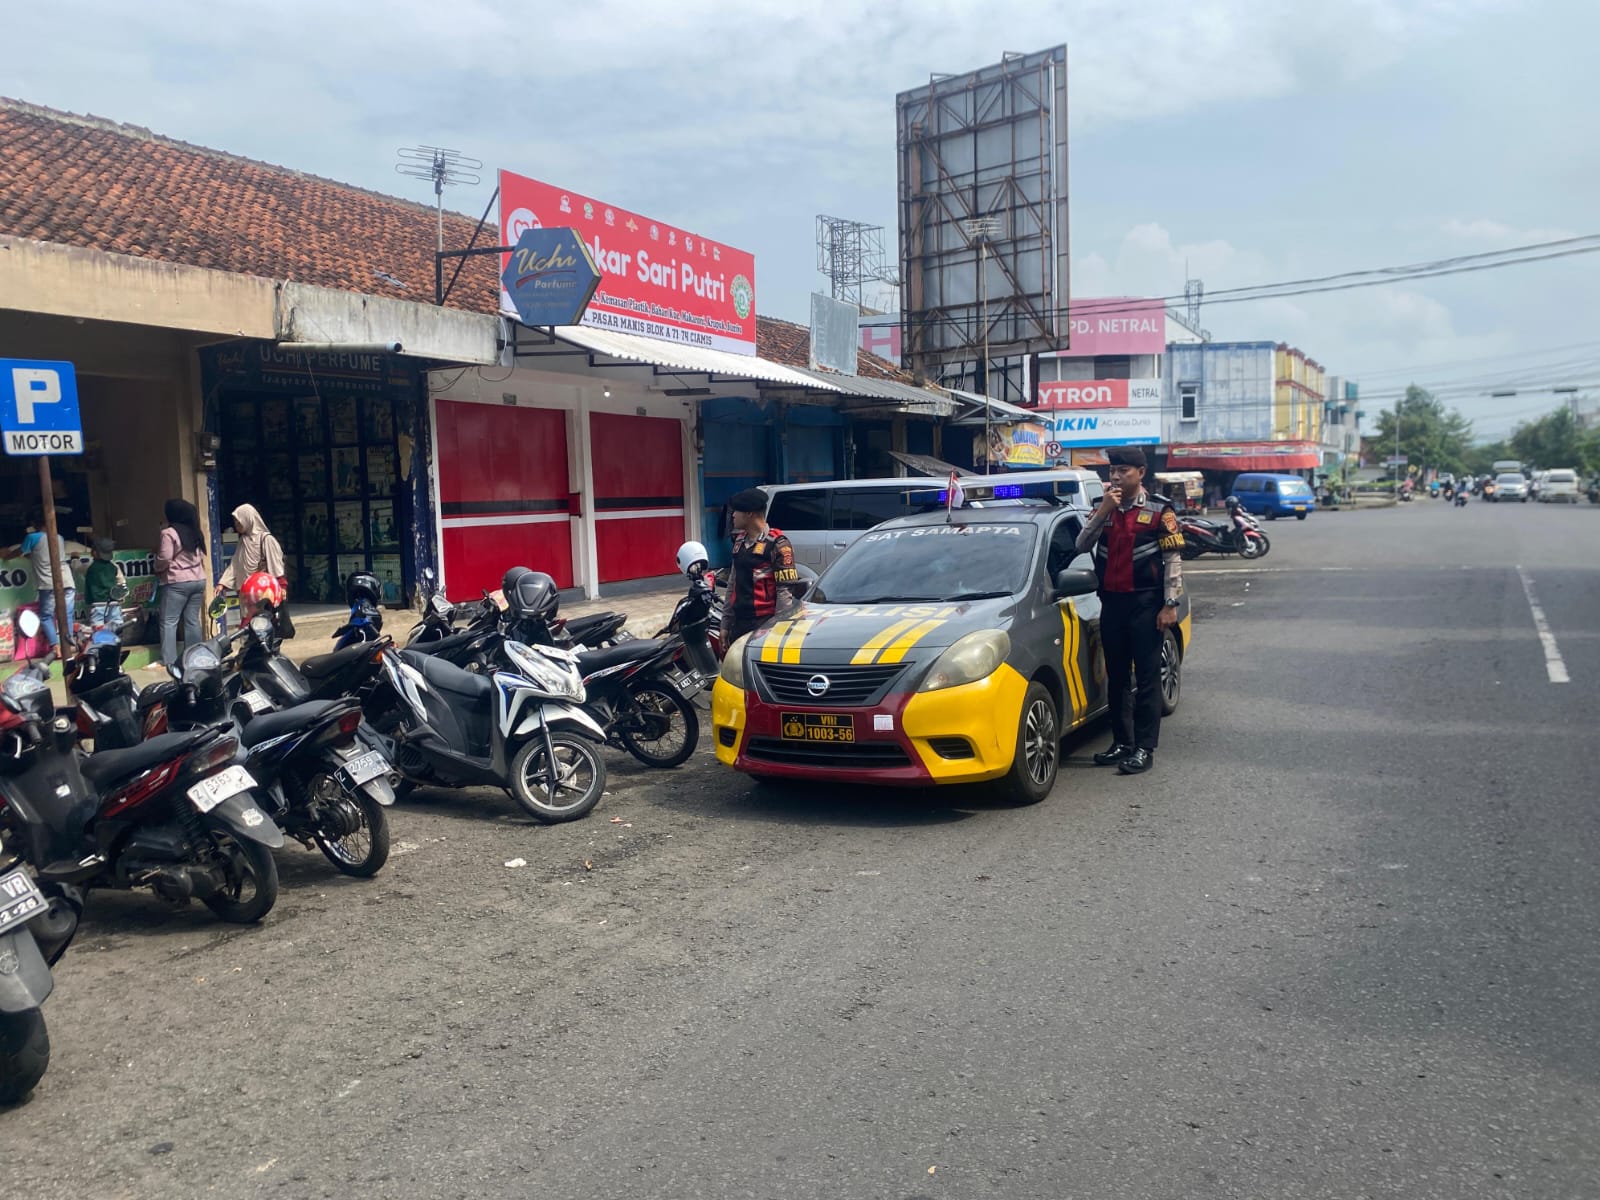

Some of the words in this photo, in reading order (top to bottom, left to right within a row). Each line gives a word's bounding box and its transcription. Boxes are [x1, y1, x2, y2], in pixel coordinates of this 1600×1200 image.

[516, 243, 577, 274] Uchi
[637, 250, 677, 290] Sari
[682, 262, 725, 303] Putri
[592, 311, 619, 328] PASAR
[620, 316, 645, 333] MANIS
[646, 323, 664, 337] BLOK
[665, 327, 671, 339] A
[690, 332, 713, 346] CIAMIS
[1098, 319, 1159, 333] NETRAL
[303, 351, 381, 371] PERFUME
[12, 368, 61, 424] P
[1131, 388, 1160, 398] NETRAL
[12, 434, 74, 450] MOTOR
[865, 531, 907, 543] SAT
[911, 525, 1021, 537] SAMAPTA
[789, 606, 958, 619] POLISI
[821, 715, 838, 726] VIII
[807, 727, 853, 741] 1003-56
[337, 771, 346, 782] Z
[193, 789, 204, 799] Z
